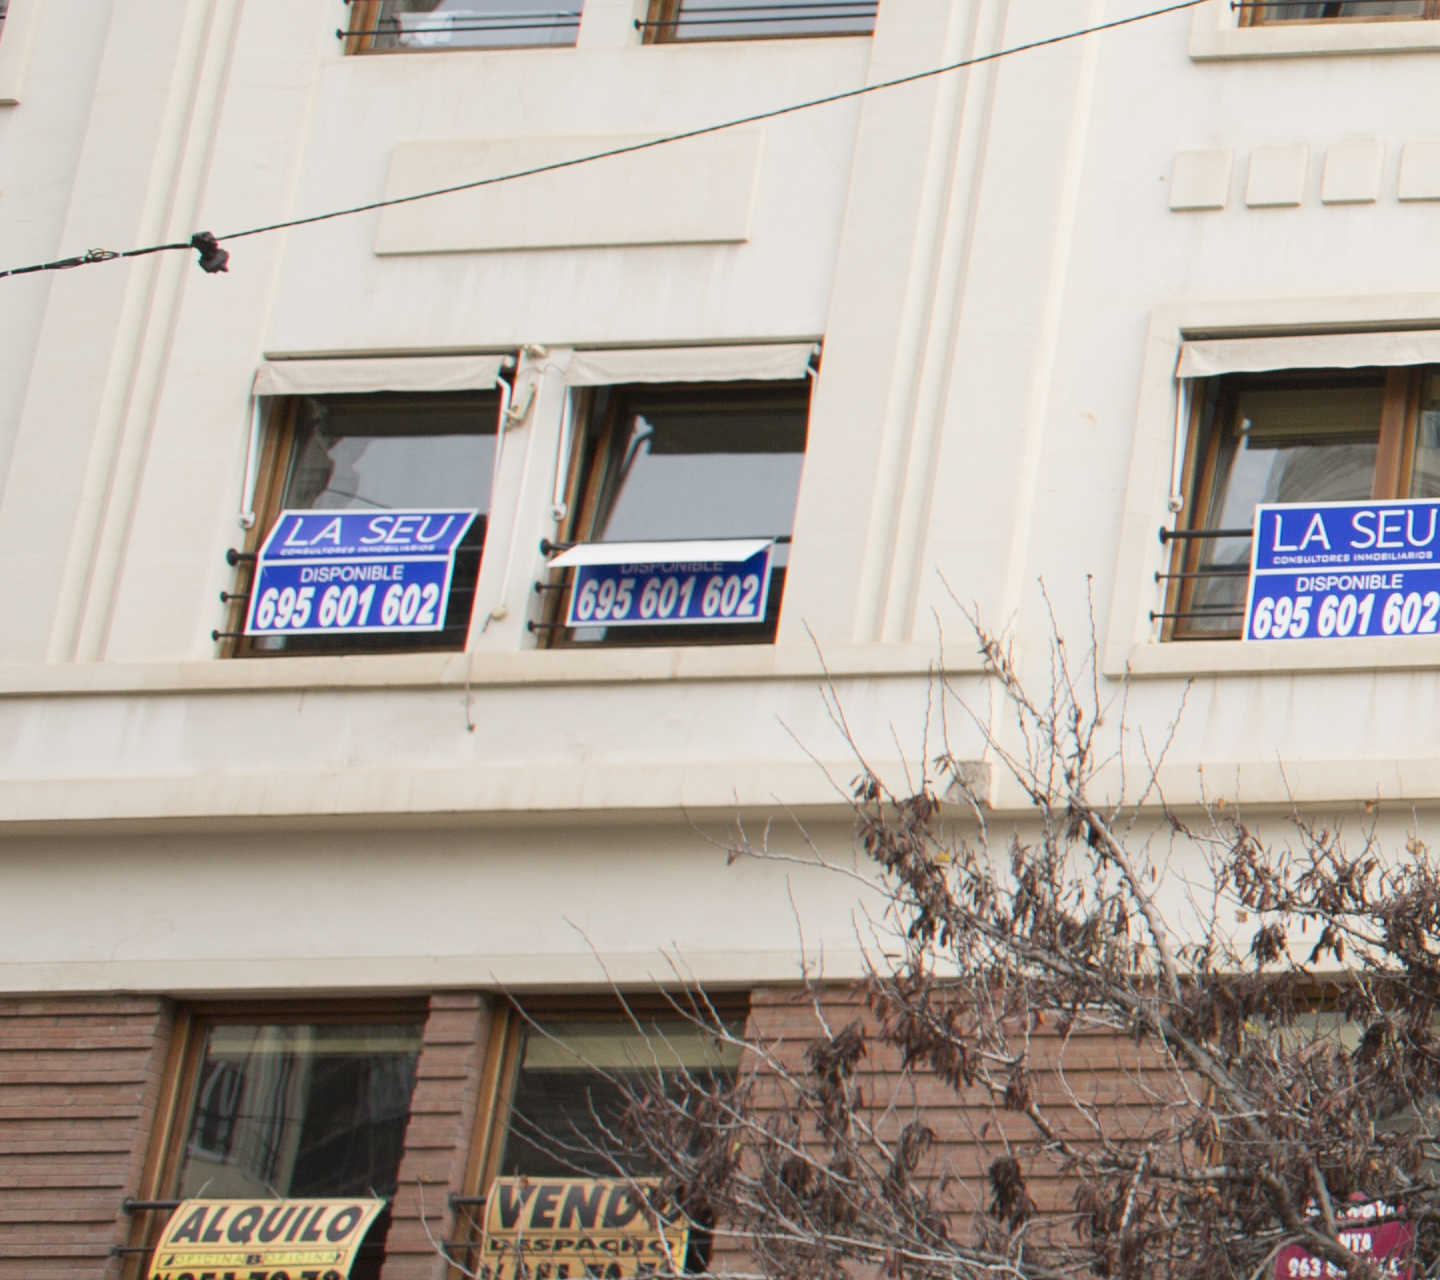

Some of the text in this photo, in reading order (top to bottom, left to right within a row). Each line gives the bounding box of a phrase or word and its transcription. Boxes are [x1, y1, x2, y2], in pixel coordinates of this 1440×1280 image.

[283, 515, 455, 546] LA SEU
[1272, 508, 1438, 552] LA SEU
[300, 564, 405, 583] DISPONIBLE
[1272, 550, 1433, 565] CONSULTORES INMOBILIARIOS
[577, 574, 760, 620] 695 601 602
[1296, 573, 1404, 592] DISPONIBLE
[256, 583, 440, 629] 695 601 602
[1252, 590, 1440, 639] 695 601 602
[168, 1206, 364, 1245] ALQUILO
